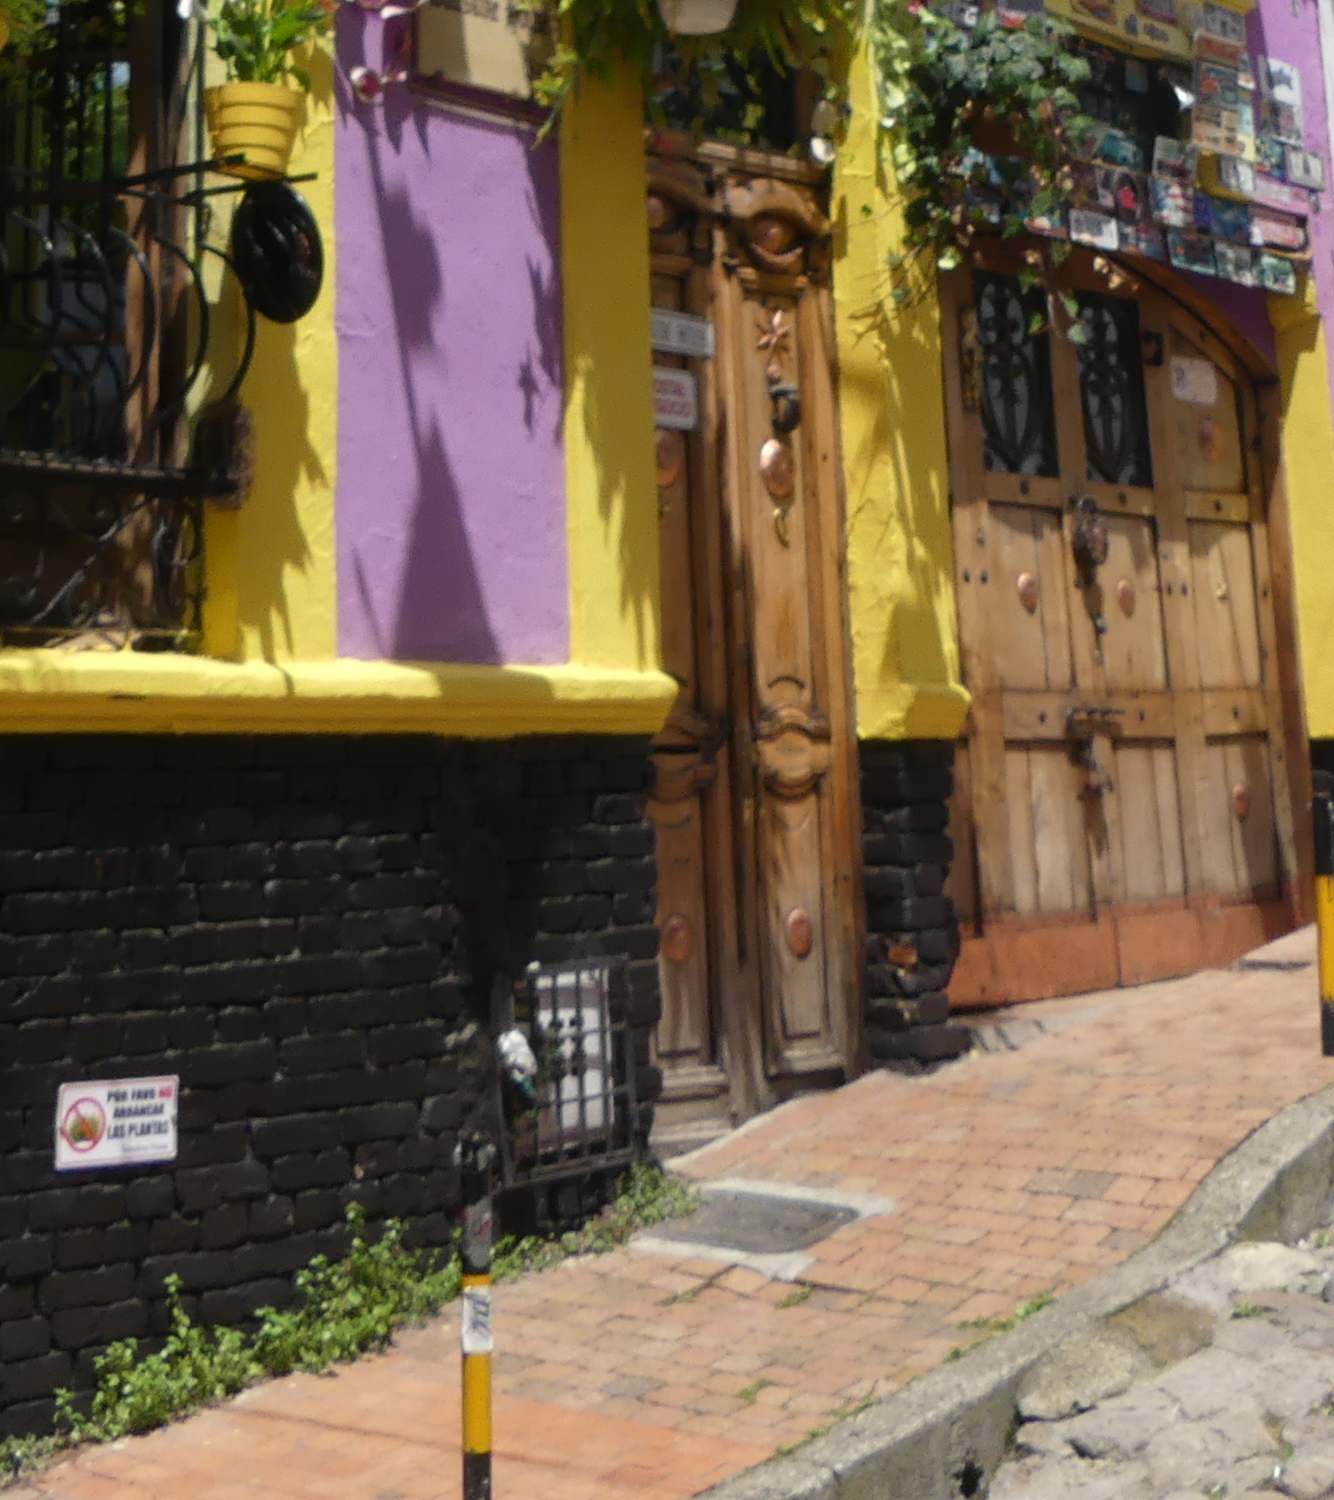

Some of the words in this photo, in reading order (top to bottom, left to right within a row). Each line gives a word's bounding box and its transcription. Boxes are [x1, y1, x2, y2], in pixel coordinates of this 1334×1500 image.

[107, 1089, 128, 1102] POR
[113, 1103, 164, 1118] ARRANCAR
[107, 1123, 126, 1139] LAS
[128, 1120, 169, 1137] PLANTAS
